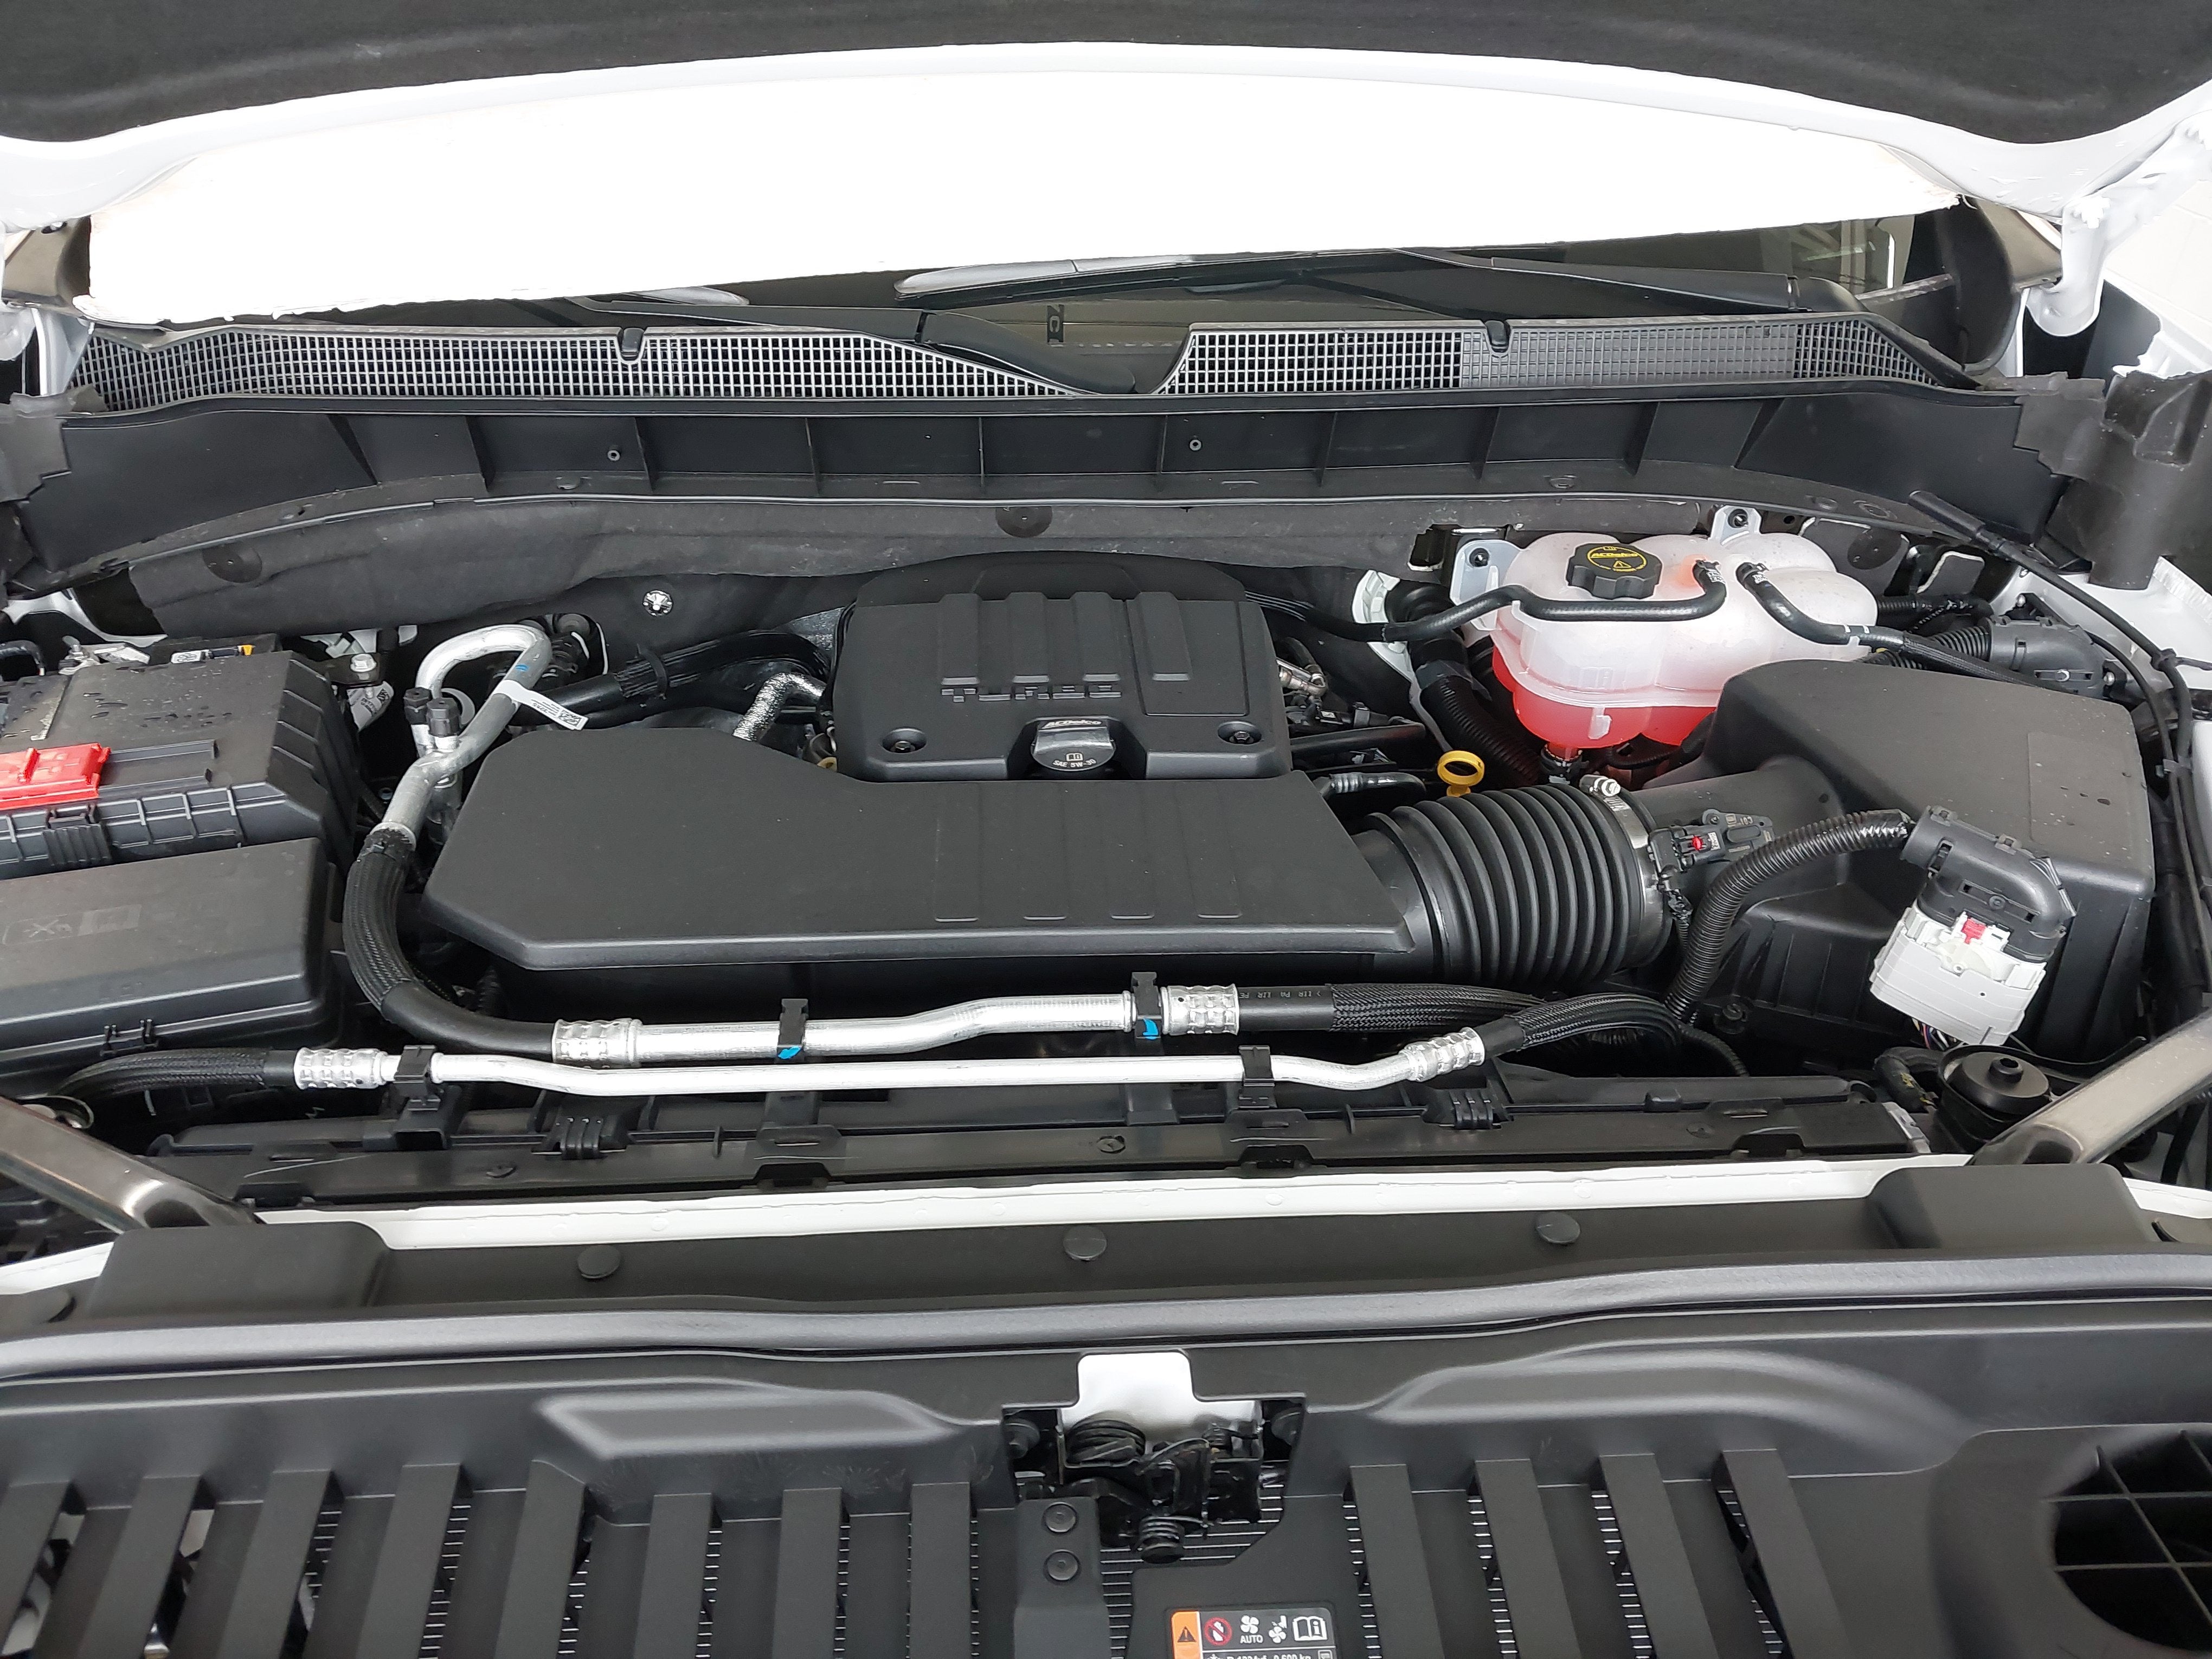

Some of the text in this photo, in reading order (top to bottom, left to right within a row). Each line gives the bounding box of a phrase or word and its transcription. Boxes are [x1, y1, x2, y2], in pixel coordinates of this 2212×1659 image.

[941, 684, 1123, 702] TURBO
[1070, 758, 1097, 767] 5W-30
[1240, 1635, 1264, 1644] AUTO
